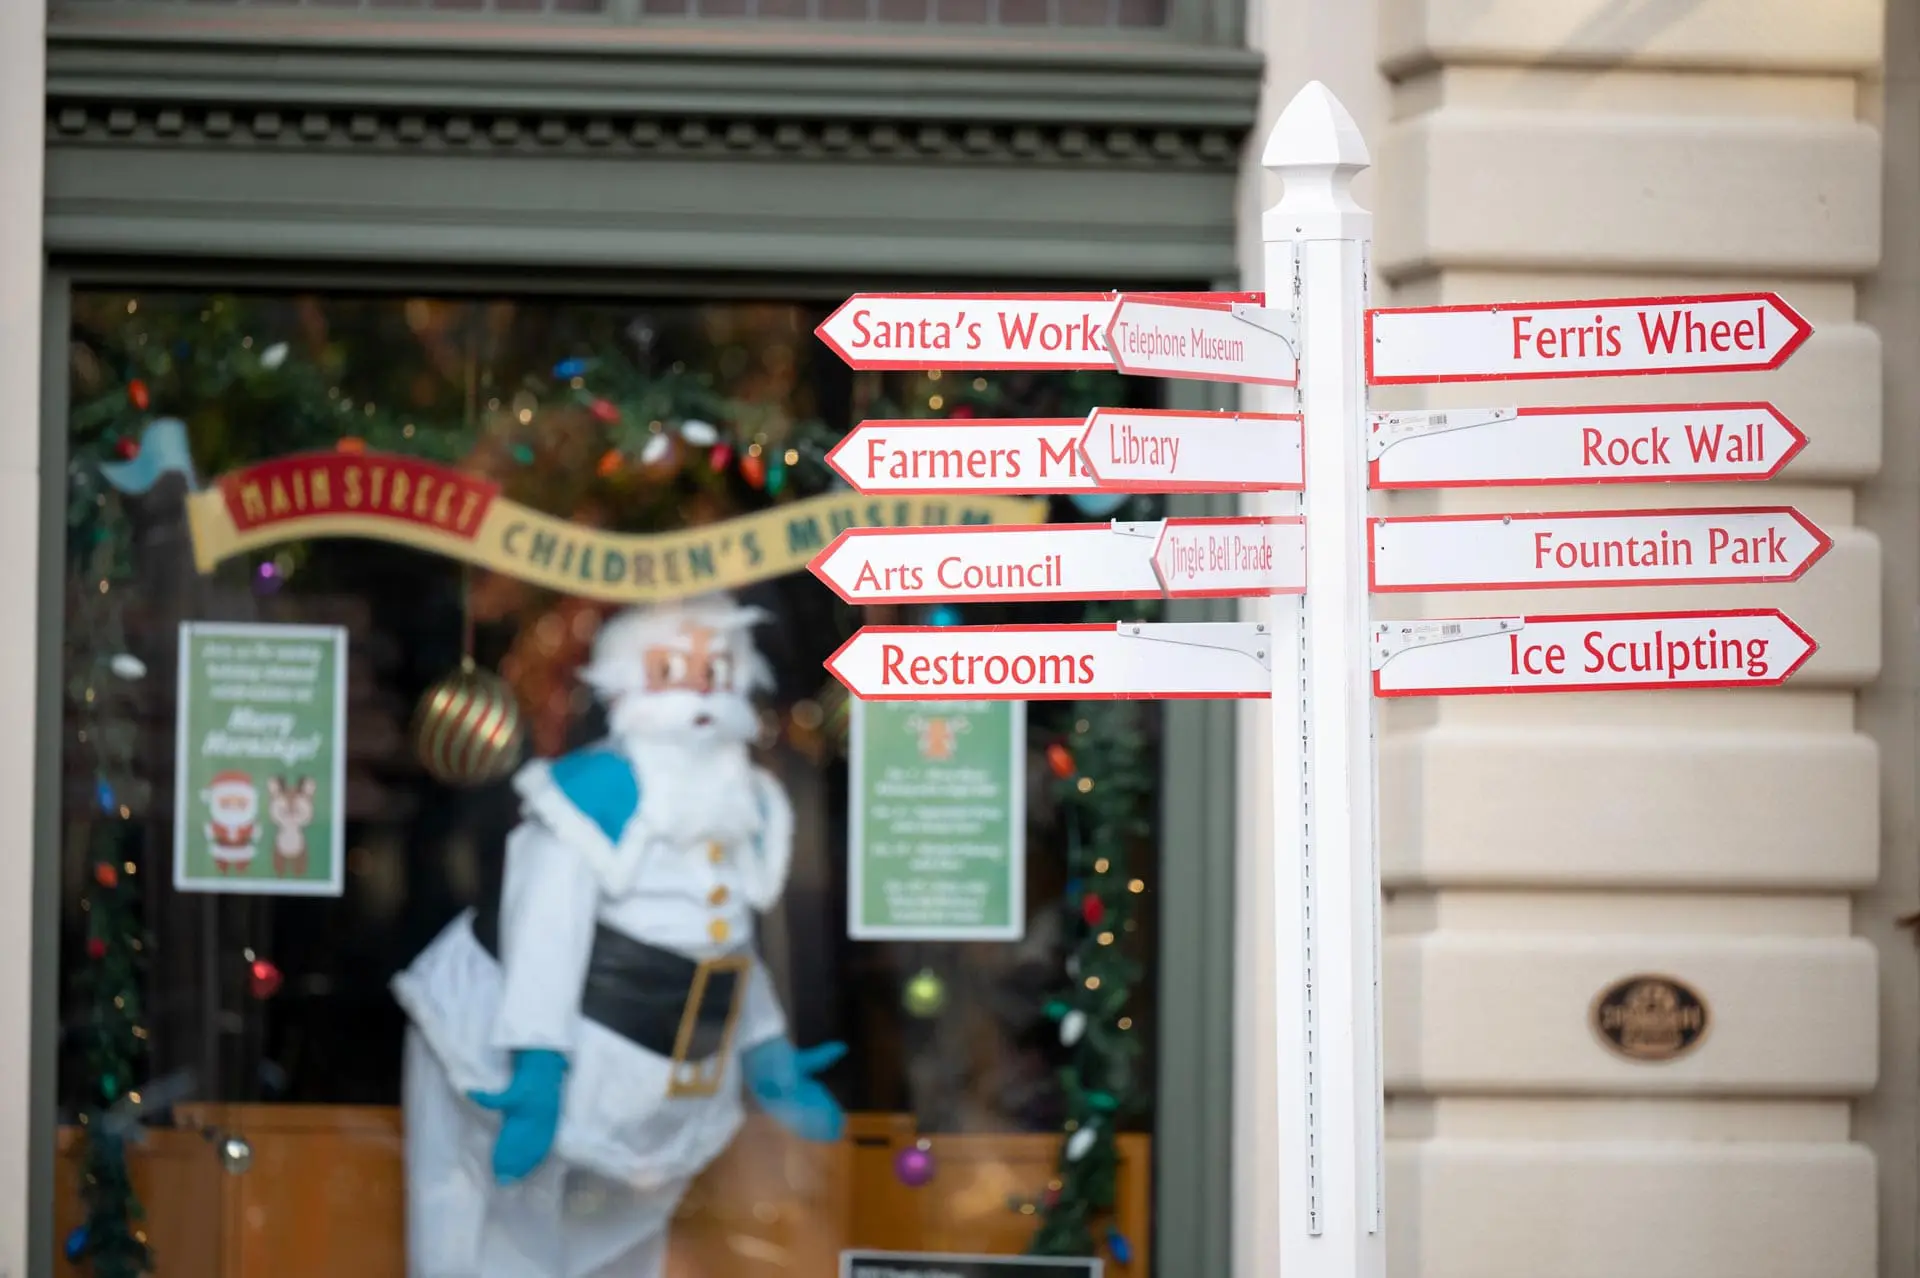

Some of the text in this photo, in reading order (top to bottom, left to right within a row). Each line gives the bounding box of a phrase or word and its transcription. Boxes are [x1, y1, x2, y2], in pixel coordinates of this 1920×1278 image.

[851, 309, 1108, 352] Santa's Work
[1120, 320, 1245, 363] Telephone Museum
[1512, 306, 1766, 360] Ferris Wheel
[867, 438, 1021, 479] Farmers
[1109, 423, 1180, 475] Library
[1582, 423, 1765, 467] Rock Wall
[239, 466, 333, 521] MAIN
[343, 465, 481, 531] STREET
[1170, 535, 1273, 580] Jingle Bell Parade
[1534, 527, 1789, 570] Fountain Park
[853, 555, 1060, 592] Arts Council
[881, 643, 1095, 687] Restrooms
[1509, 628, 1769, 679] Ice Sculpting
